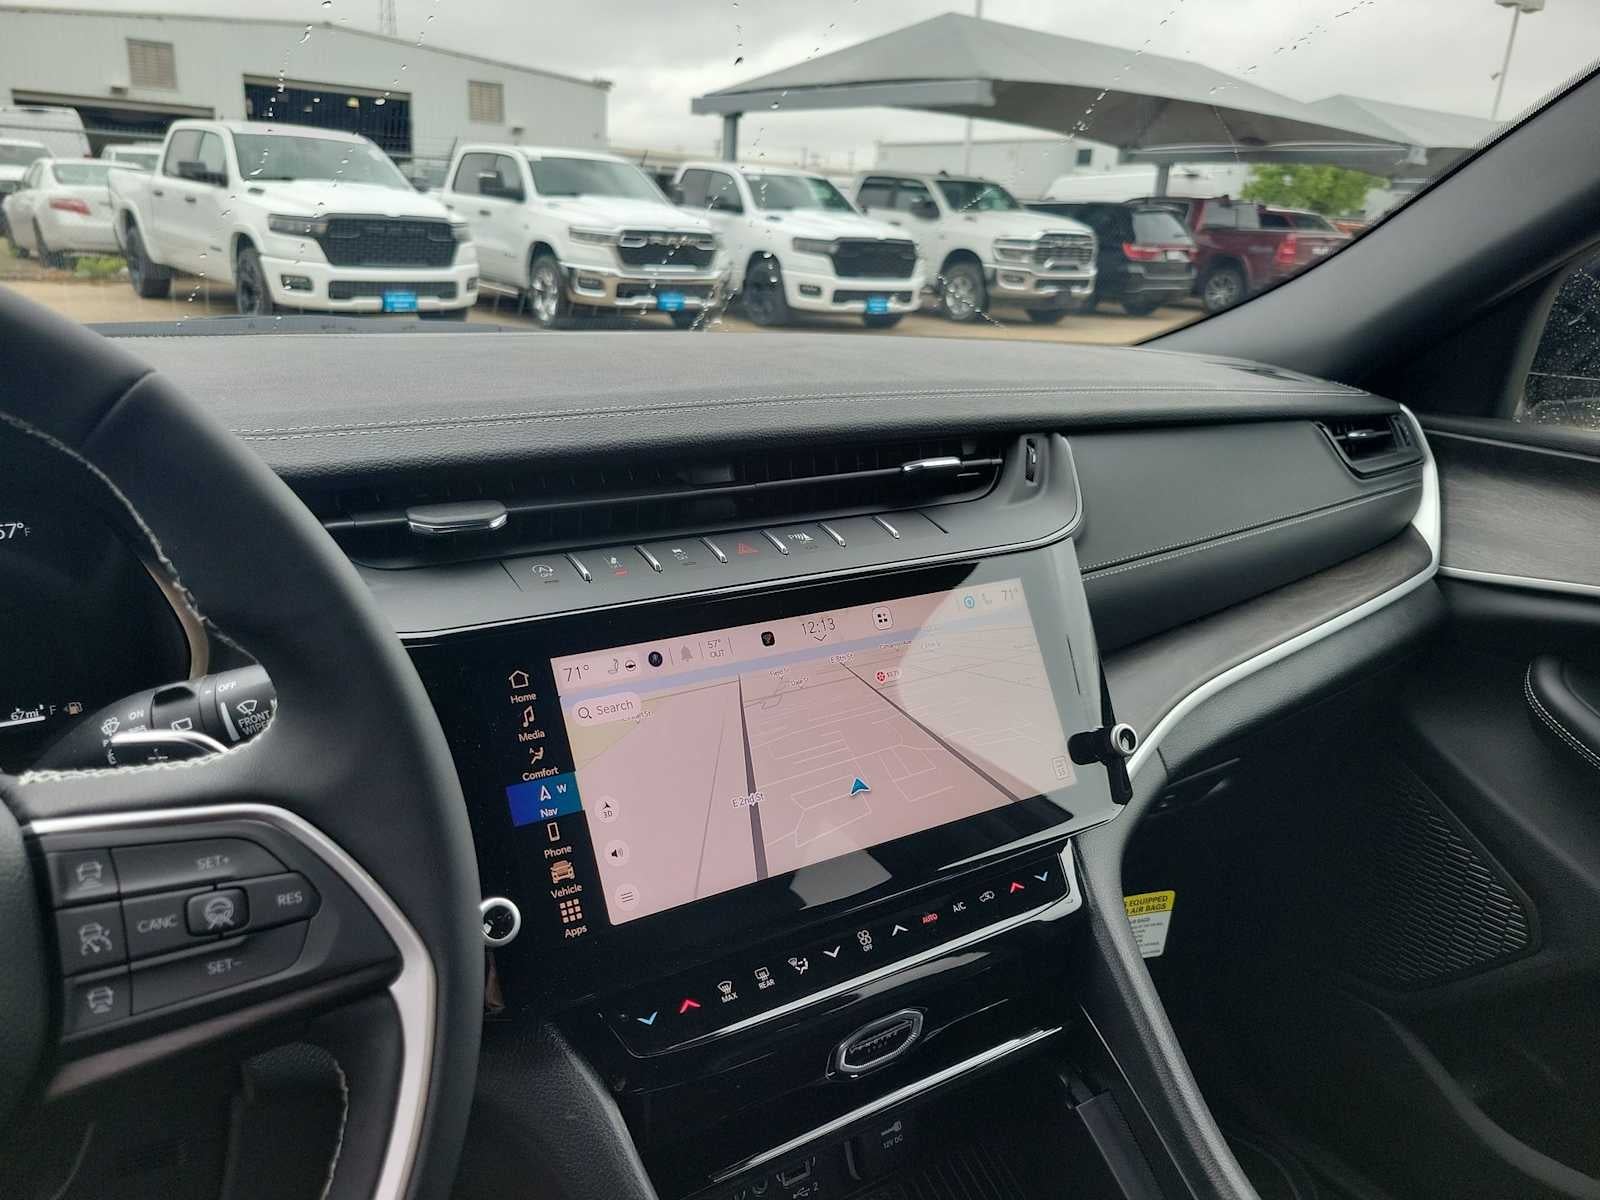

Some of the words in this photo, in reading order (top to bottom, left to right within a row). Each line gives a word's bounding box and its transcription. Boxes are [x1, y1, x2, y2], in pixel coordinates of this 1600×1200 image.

[802, 618, 835, 635] 12:13
[563, 665, 590, 681] 71°
[510, 691, 536, 704] Home
[597, 699, 634, 716] Search
[238, 710, 271, 728] FRONT
[518, 729, 546, 742] Media
[522, 766, 559, 781] Comfort
[556, 784, 567, 793] W
[540, 806, 558, 818] Nav
[544, 844, 572, 859] Phone
[550, 883, 583, 899] Vehicle
[277, 892, 303, 906] RES
[951, 901, 967, 913] A/C
[137, 915, 177, 933] CANC
[564, 924, 588, 939] Apps
[758, 978, 776, 990] REAR
[721, 991, 739, 1003] MAX
